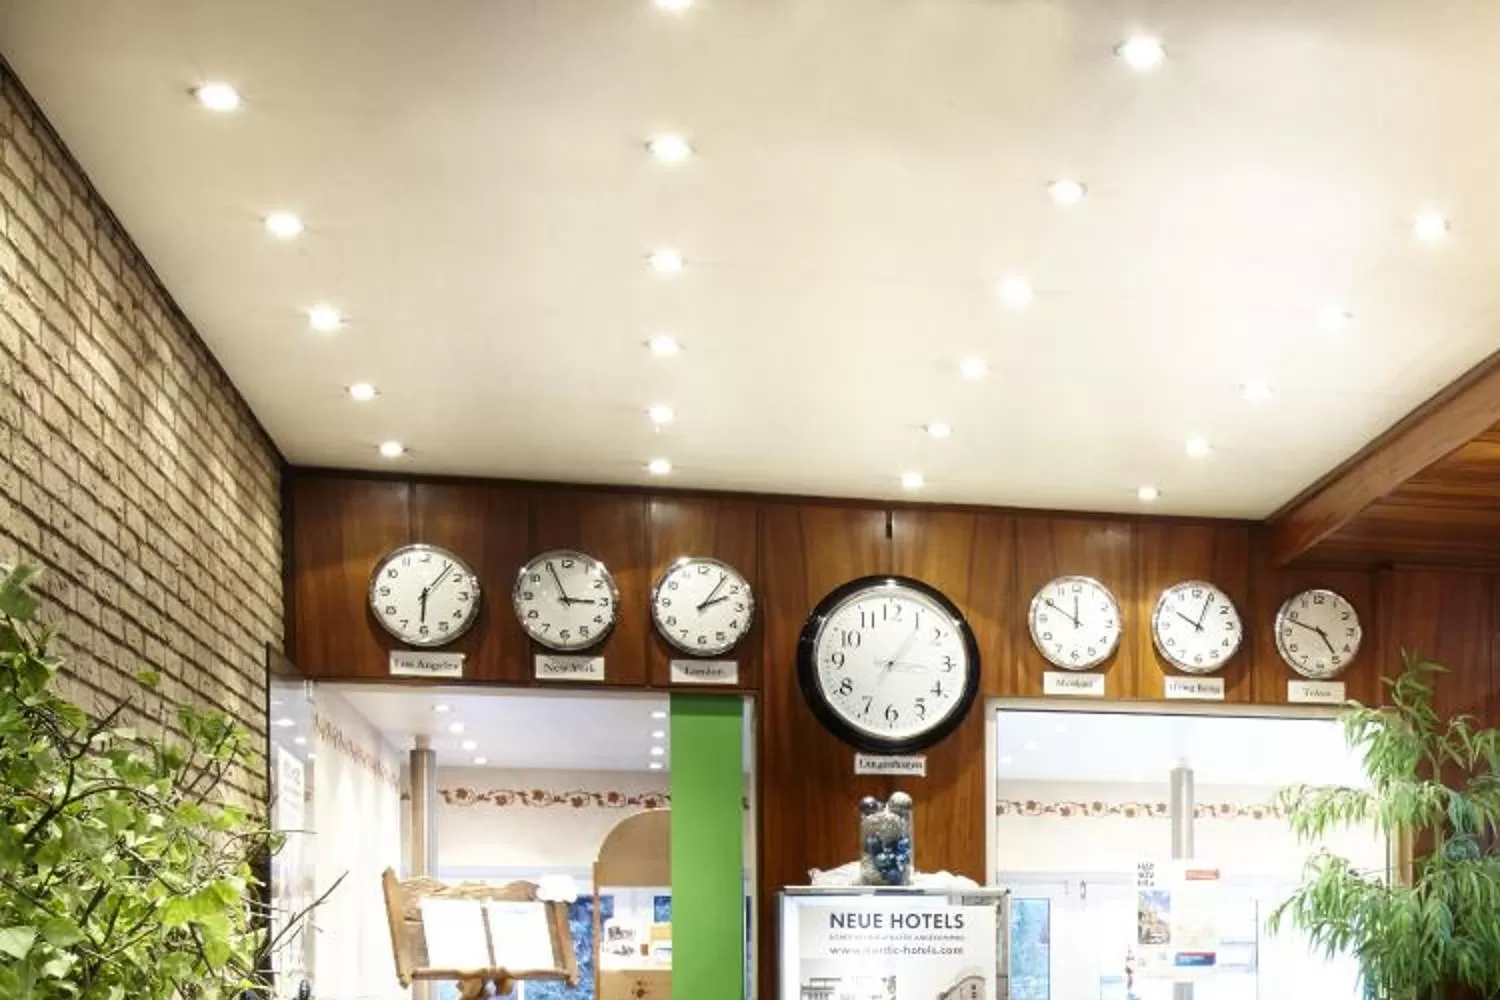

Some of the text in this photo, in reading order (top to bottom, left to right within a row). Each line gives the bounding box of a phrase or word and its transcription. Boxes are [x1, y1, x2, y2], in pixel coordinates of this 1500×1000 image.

[861, 611, 875, 629] 11
[883, 603, 903, 622] 12
[915, 612, 920, 629] 1
[841, 629, 861, 648] 10
[929, 628, 942, 645] 2
[831, 651, 846, 670] 9
[941, 655, 952, 673] 3
[839, 677, 853, 696] 8
[930, 680, 942, 697] 4
[861, 695, 873, 715] 7
[885, 704, 899, 723] 6
[914, 698, 926, 720] 5
[829, 913, 964, 928] NEUE HOTELS
